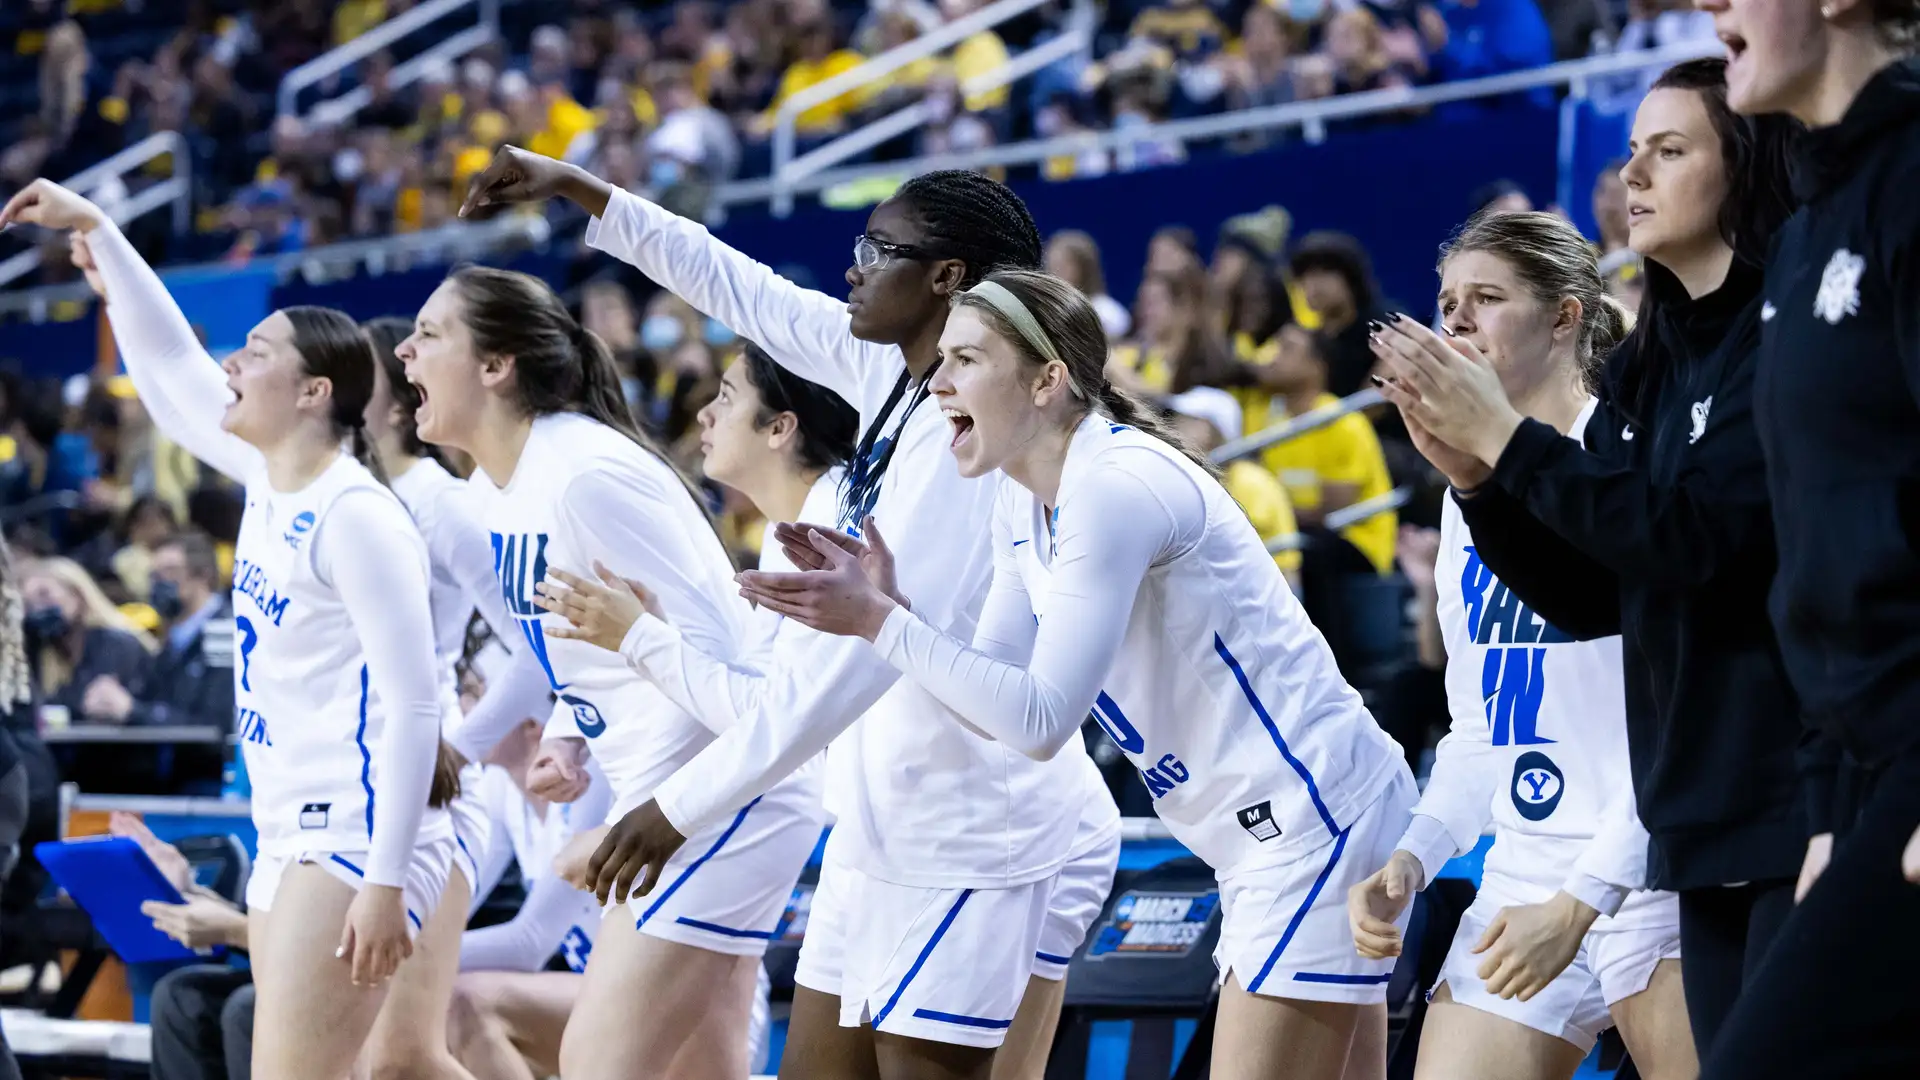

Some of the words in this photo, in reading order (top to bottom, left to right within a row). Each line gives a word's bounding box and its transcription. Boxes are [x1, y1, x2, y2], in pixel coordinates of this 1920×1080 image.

[1481, 647, 1560, 746] IN
[1522, 771, 1551, 801] Y
[1246, 808, 1261, 823] M
[1128, 896, 1194, 921] MARCH
[1121, 921, 1206, 945] MADNESS
